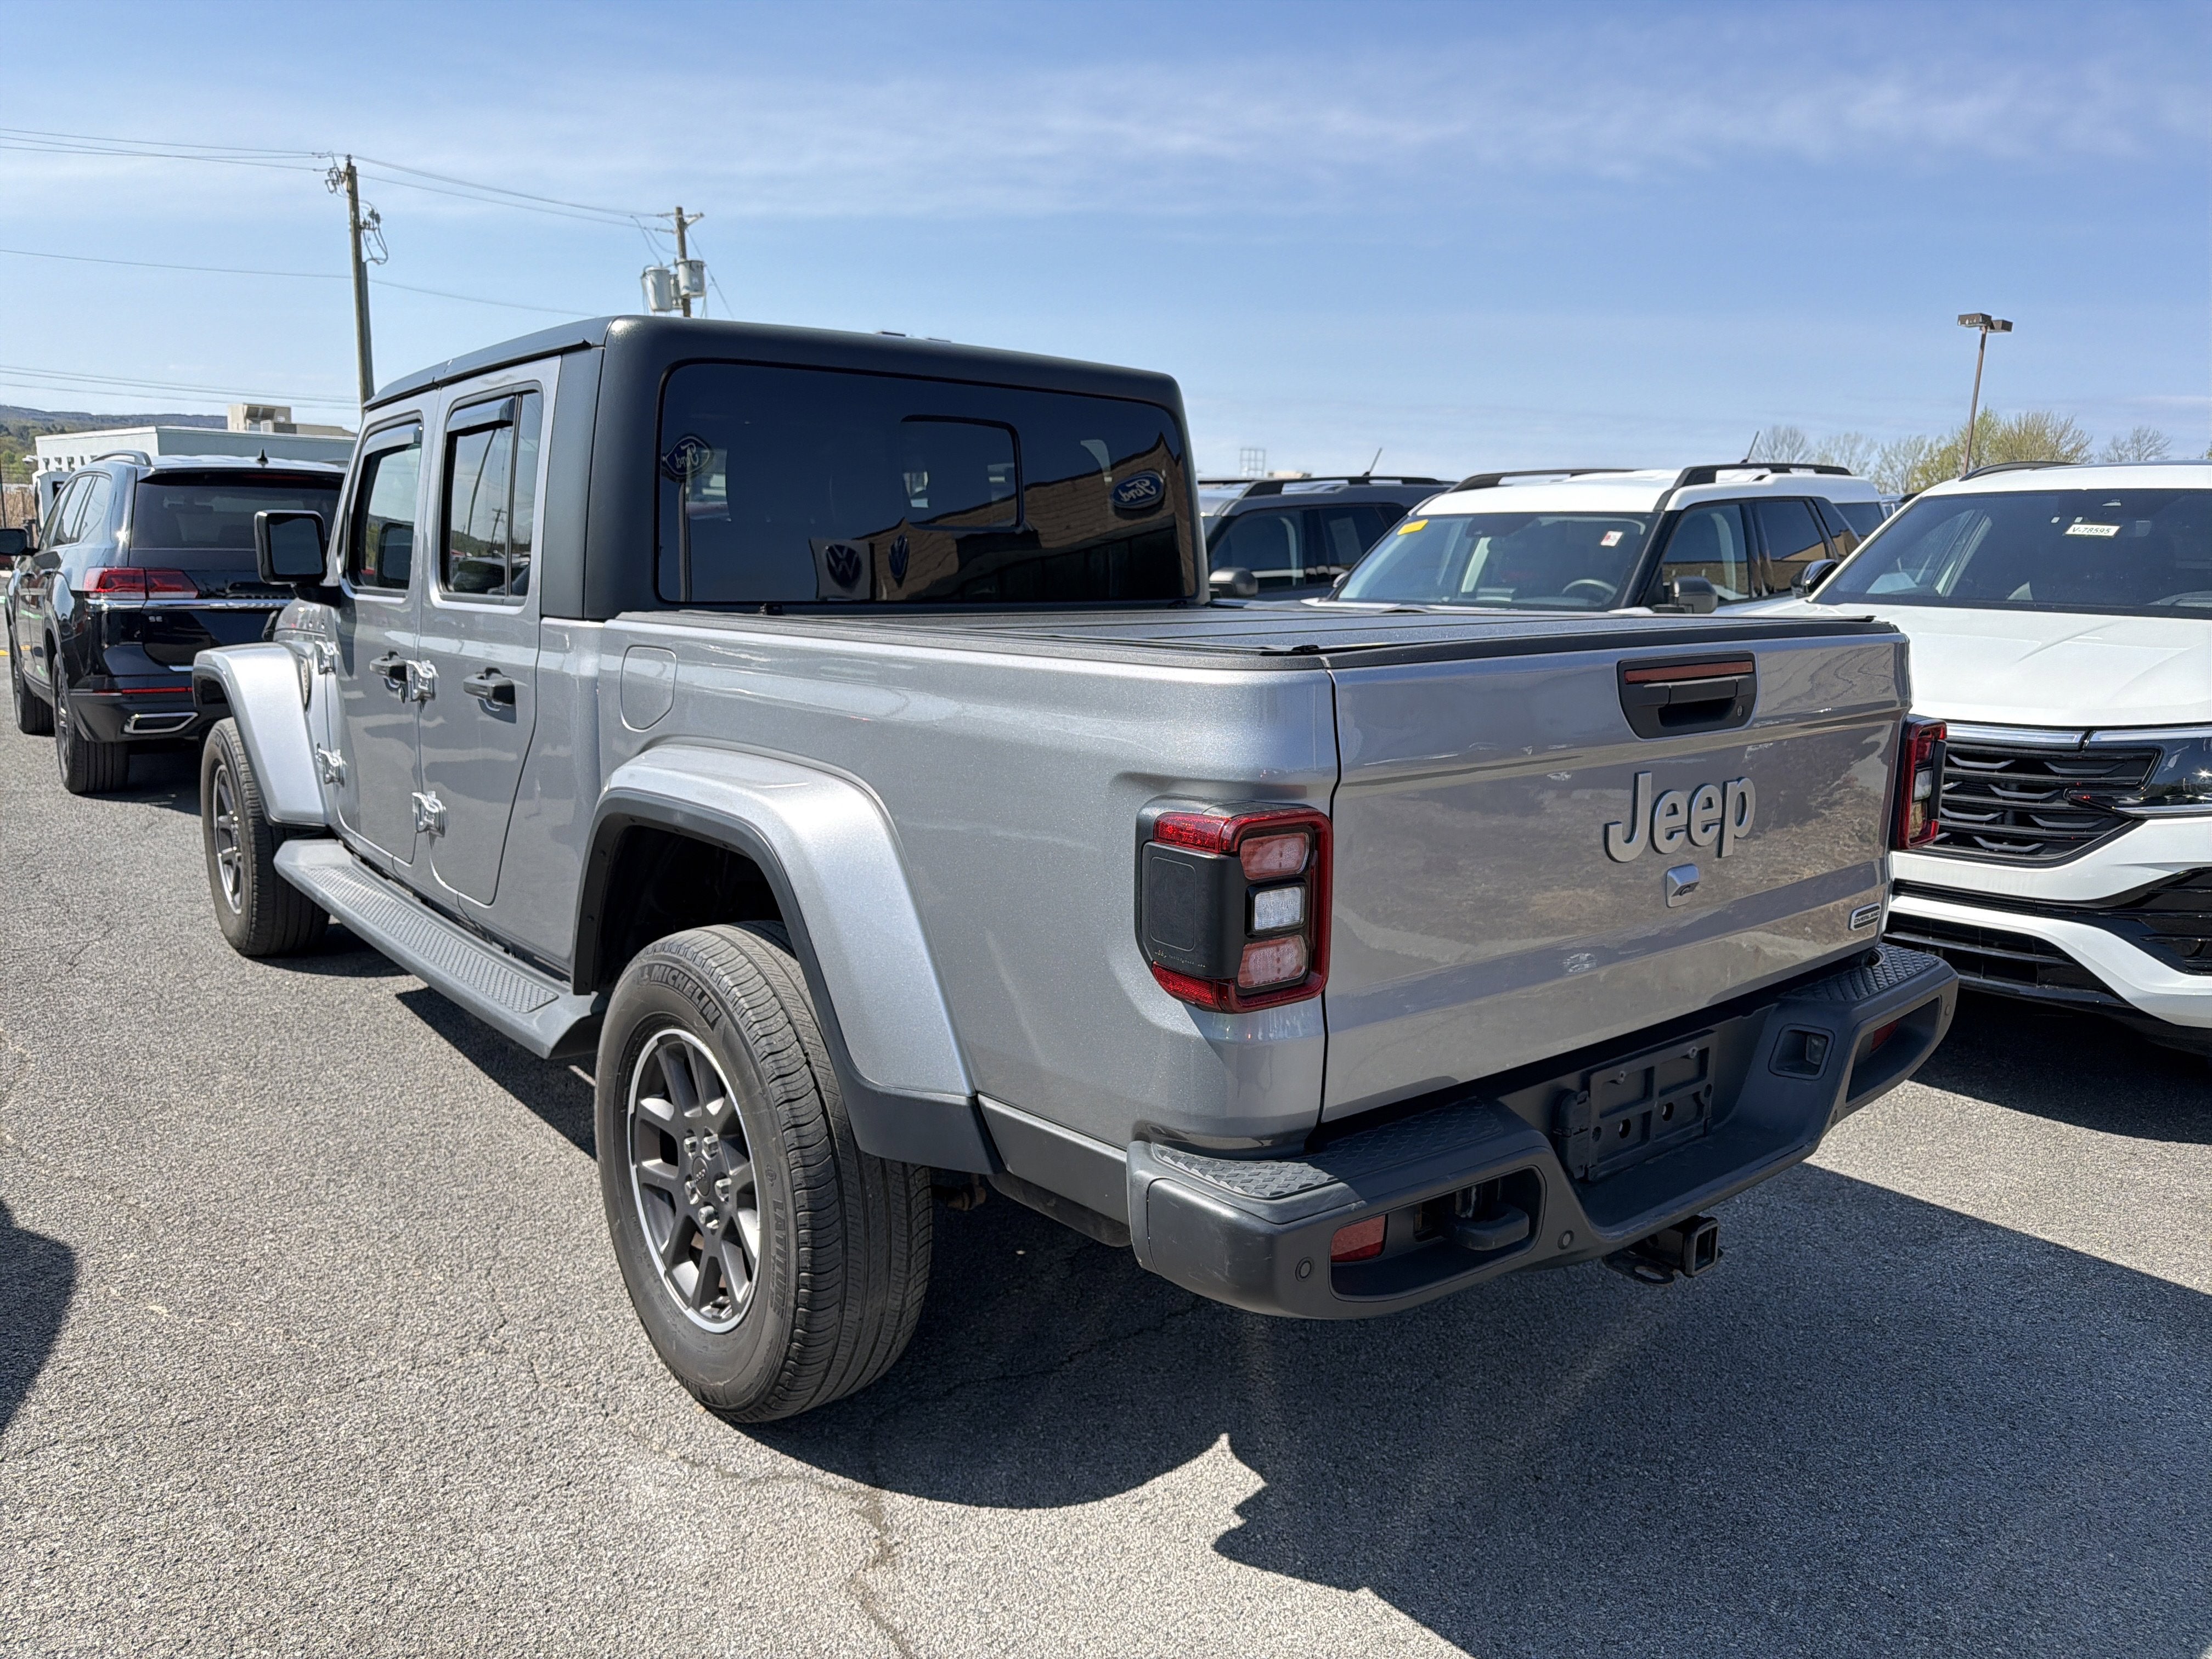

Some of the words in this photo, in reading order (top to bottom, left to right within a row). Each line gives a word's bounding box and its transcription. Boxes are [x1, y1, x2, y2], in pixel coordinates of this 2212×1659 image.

[1604, 770, 1756, 863] Jeep
[1854, 911, 1880, 923] OVERLAND
[650, 964, 721, 1023] MICHELIN
[772, 1198, 787, 1319] LATITUDE
